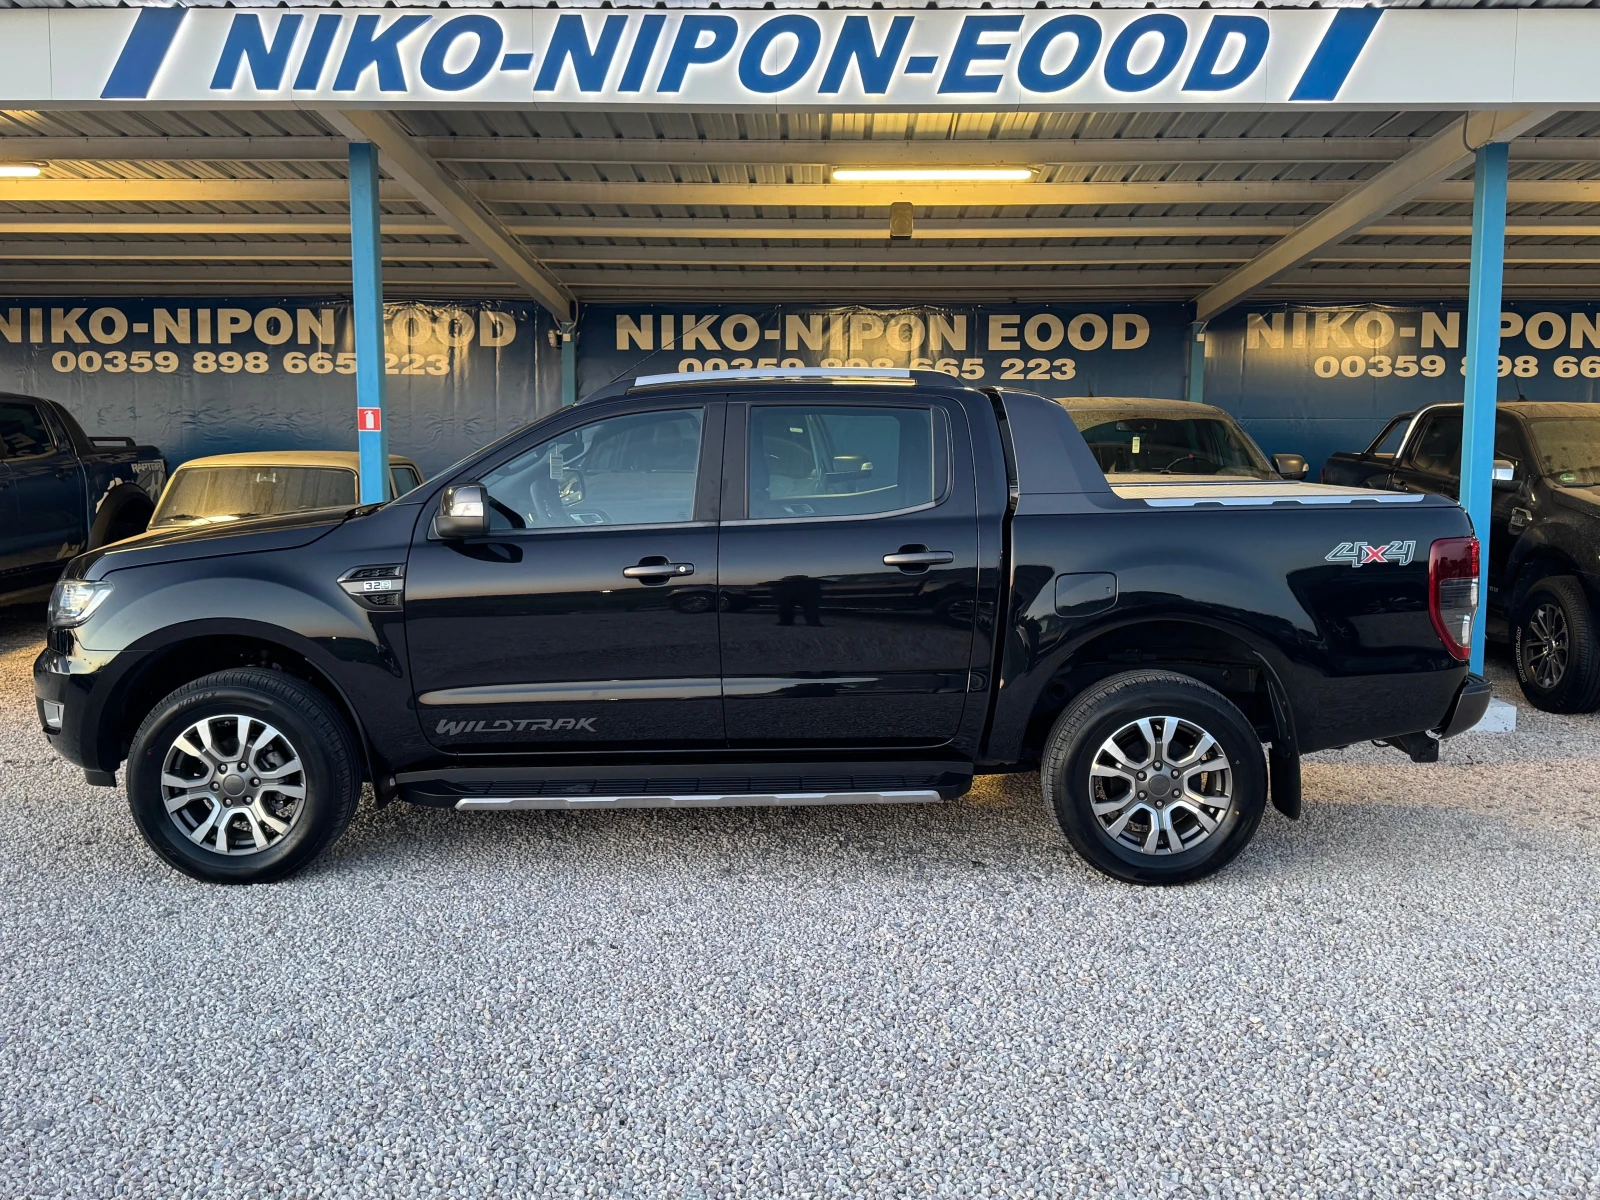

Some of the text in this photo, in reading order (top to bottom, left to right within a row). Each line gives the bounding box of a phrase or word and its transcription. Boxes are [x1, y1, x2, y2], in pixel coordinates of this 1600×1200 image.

[209, 13, 1270, 94] NIKO-NIPON-EOOD
[384, 310, 517, 348] OOD
[616, 313, 1150, 351] NIKO-NIPON EOOD
[1246, 311, 1600, 350] NIKO-NPON
[52, 351, 179, 373] 00359
[193, 351, 269, 374] 898
[283, 352, 356, 375] 665
[1000, 358, 1076, 381] 223
[1314, 355, 1446, 378] 00359
[1460, 355, 1539, 378] 98
[435, 717, 598, 735] WILDTRAK
